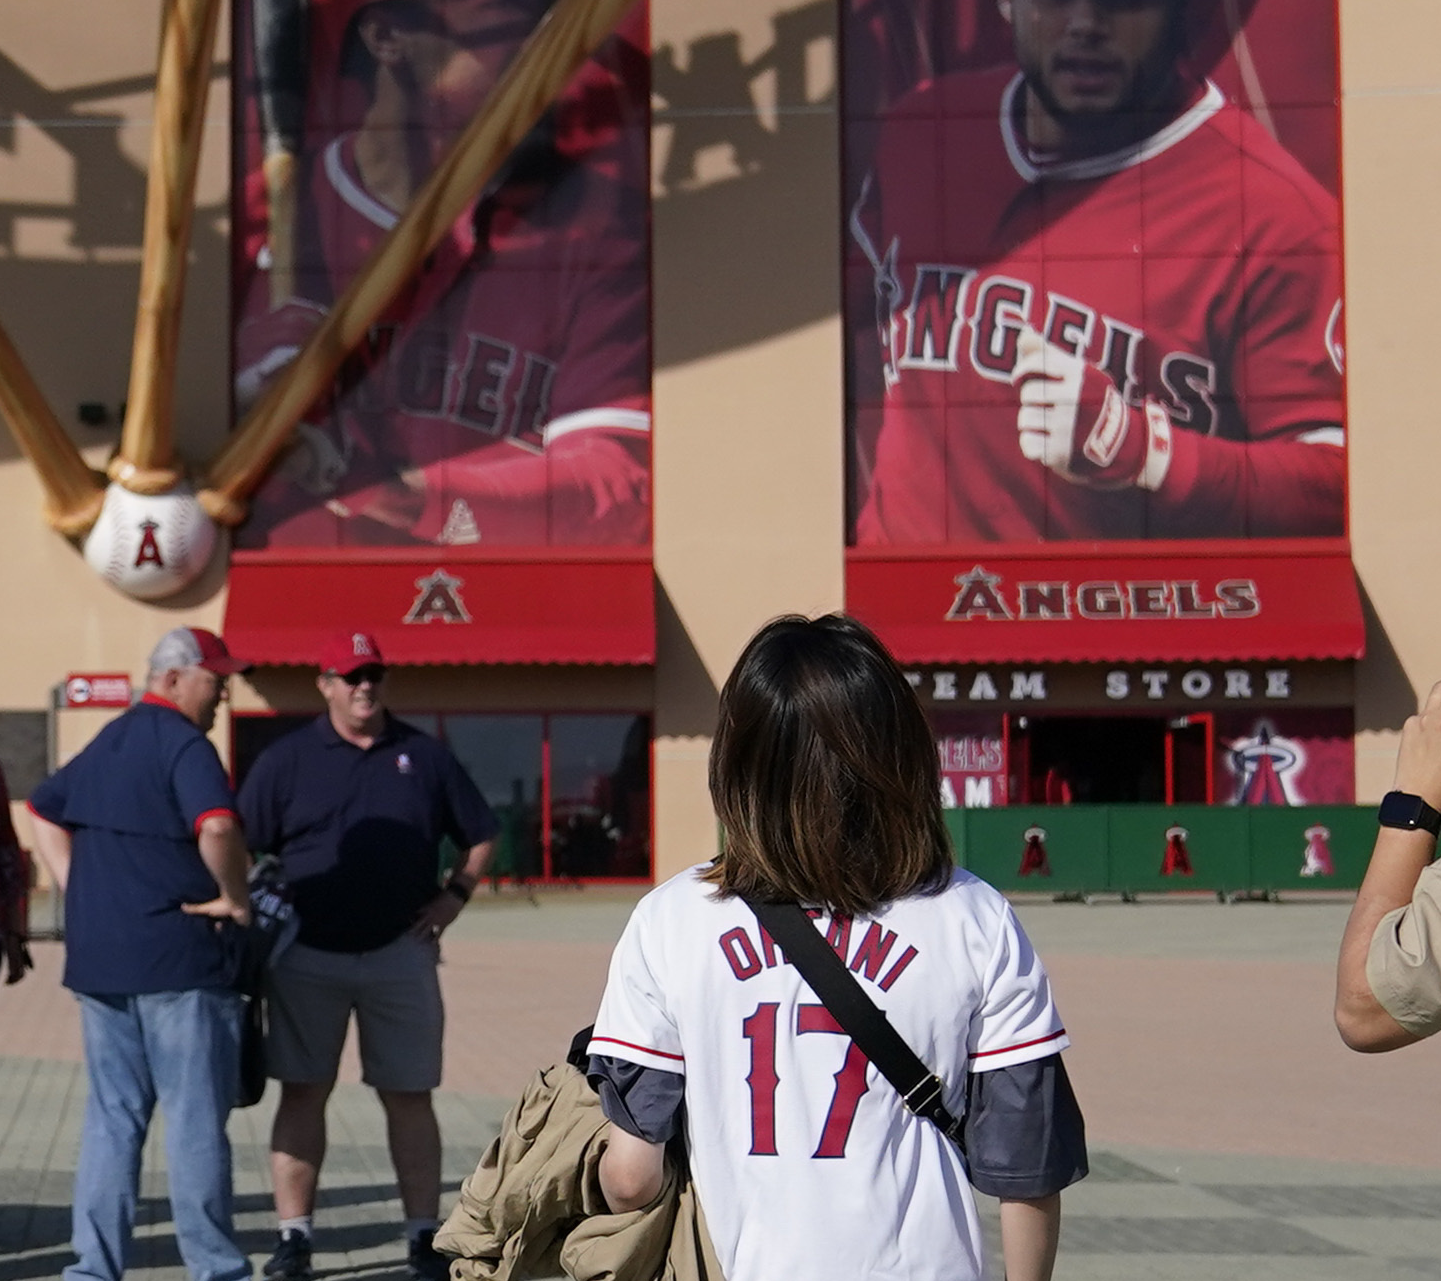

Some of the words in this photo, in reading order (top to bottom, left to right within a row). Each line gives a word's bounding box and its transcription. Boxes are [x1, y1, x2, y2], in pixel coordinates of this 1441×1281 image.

[944, 564, 1262, 623] ANGELS
[908, 671, 1047, 700] EAM
[1106, 669, 1291, 699] STORE
[742, 1001, 888, 1160] 17
